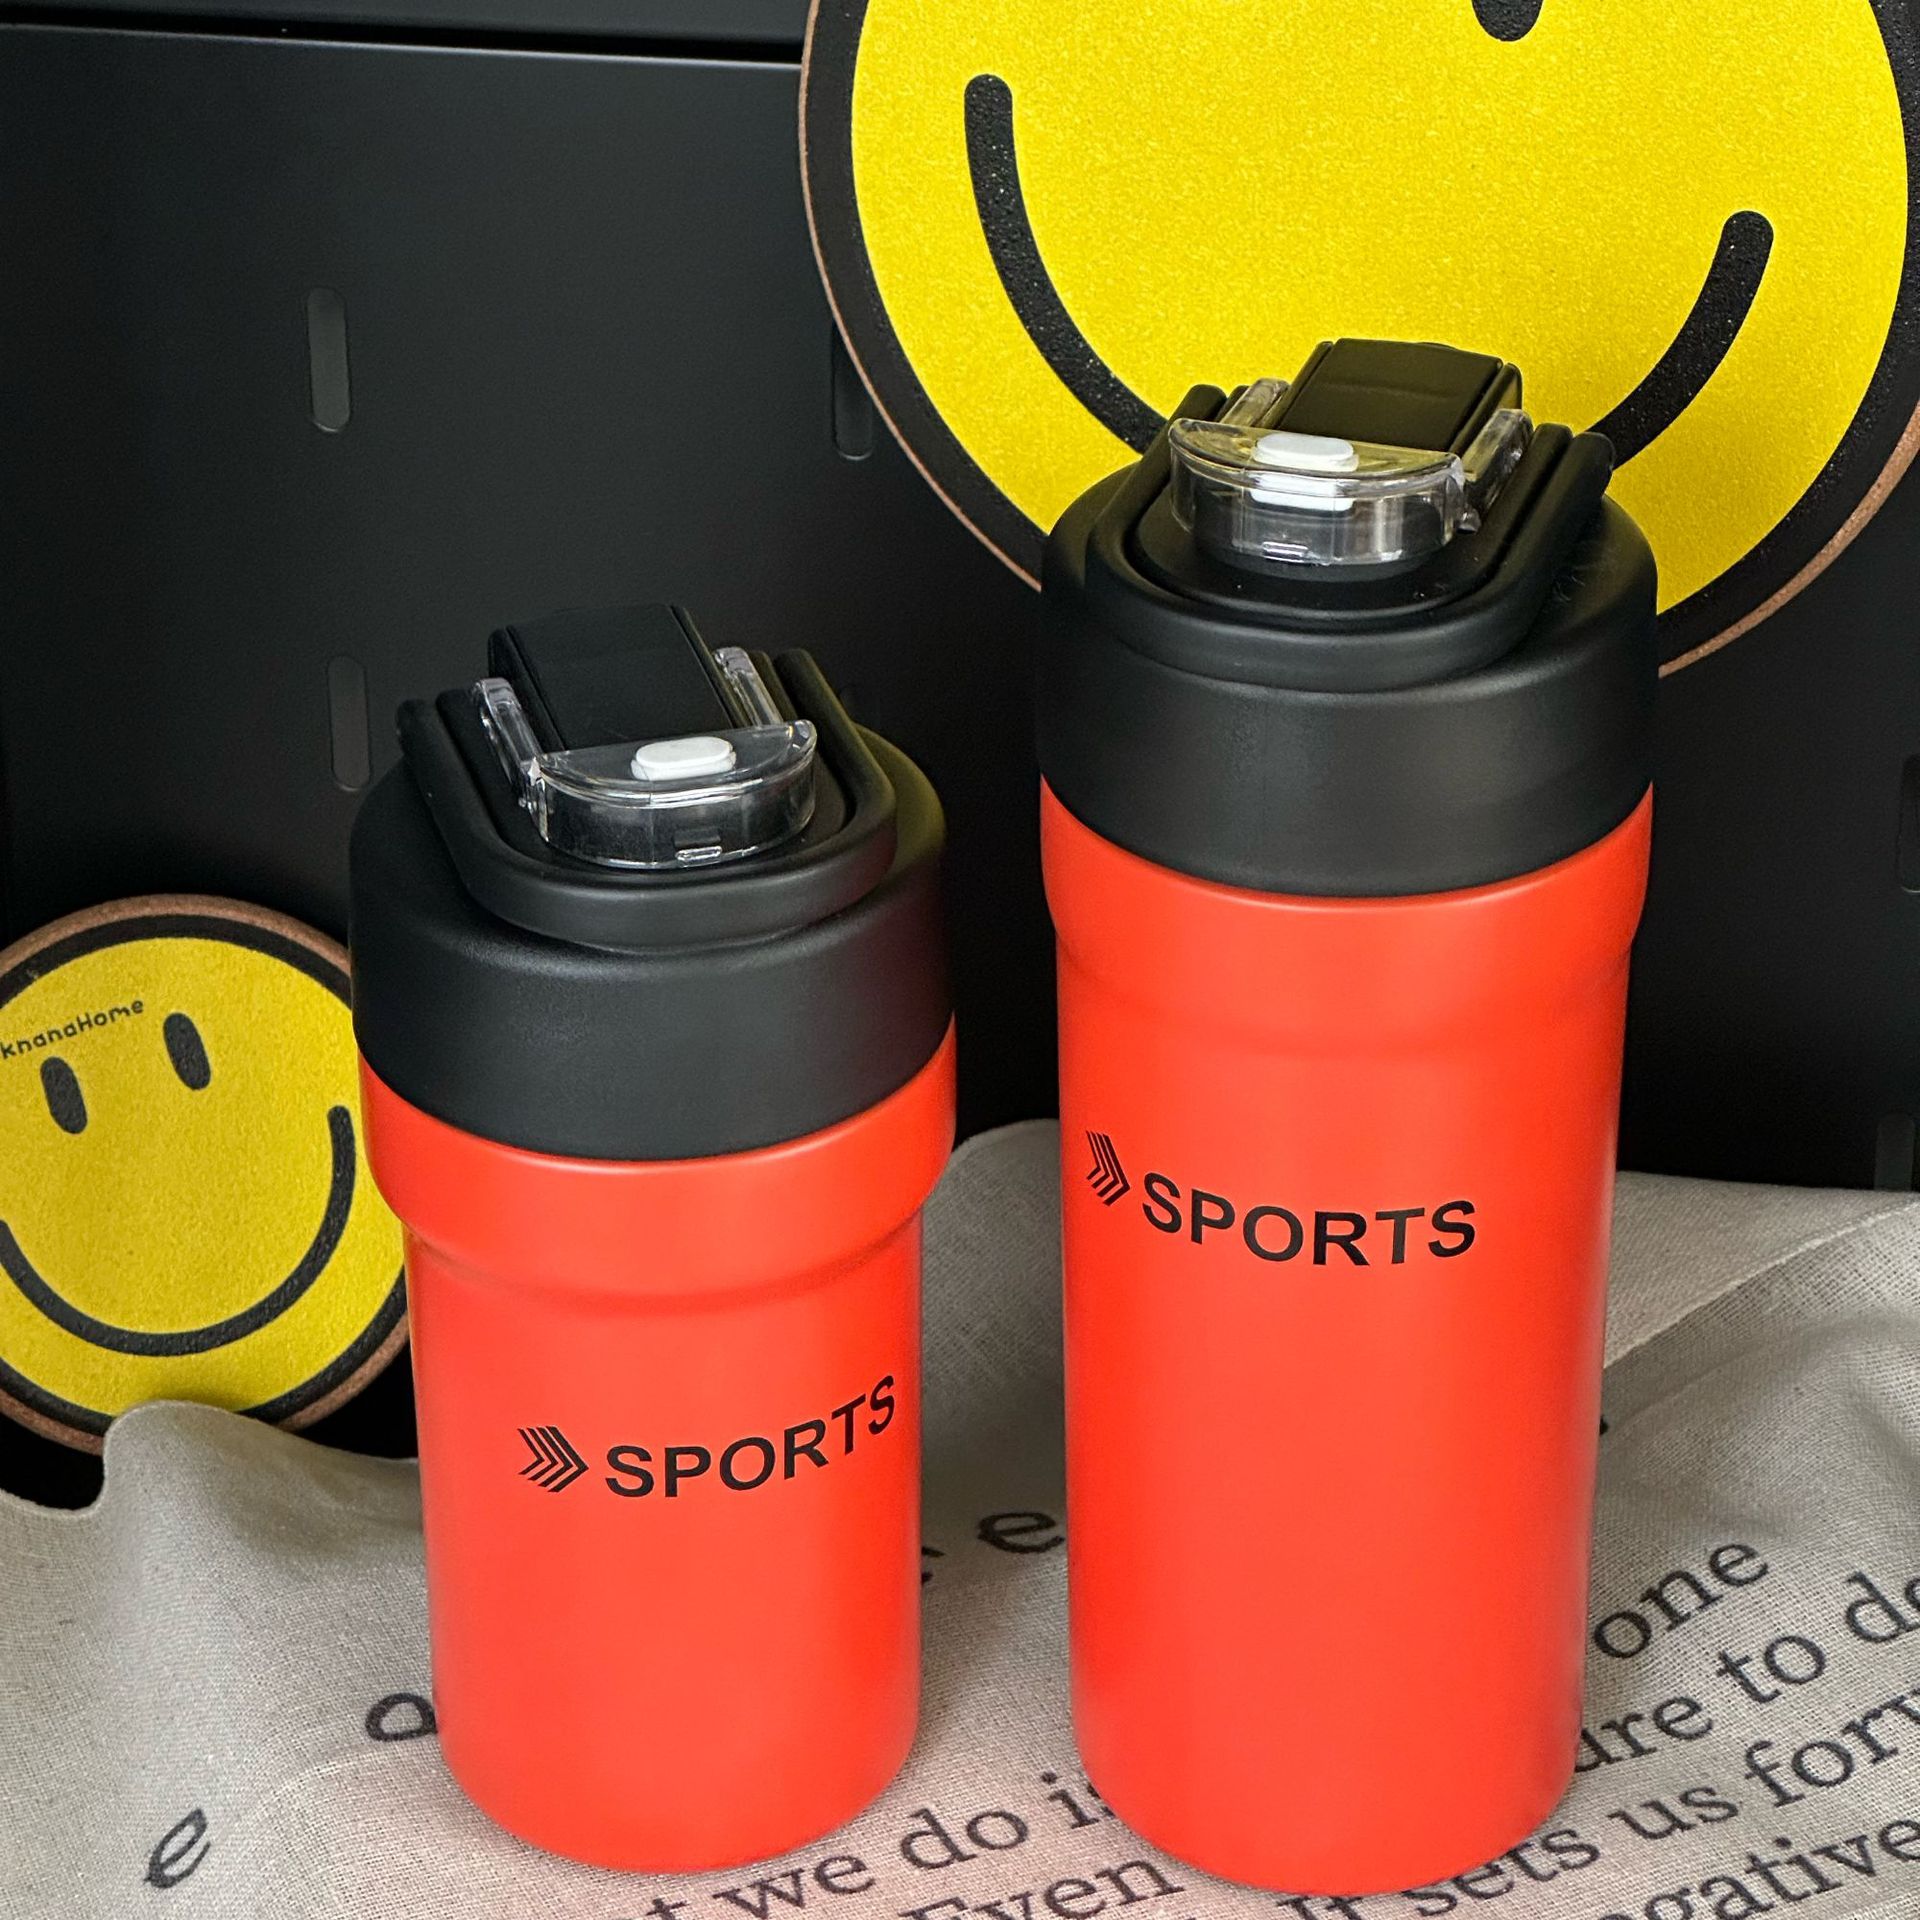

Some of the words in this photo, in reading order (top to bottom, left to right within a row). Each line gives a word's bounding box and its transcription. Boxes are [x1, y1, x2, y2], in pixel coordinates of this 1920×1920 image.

[1142, 1172, 1476, 1266] SPORTS
[605, 1375, 895, 1498] SPORTS
[1594, 1543, 1769, 1660] one
[1717, 1635, 1826, 1703] to
[711, 1855, 876, 1920] we
[900, 1808, 1030, 1869] do
[1608, 1786, 1739, 1840] us
